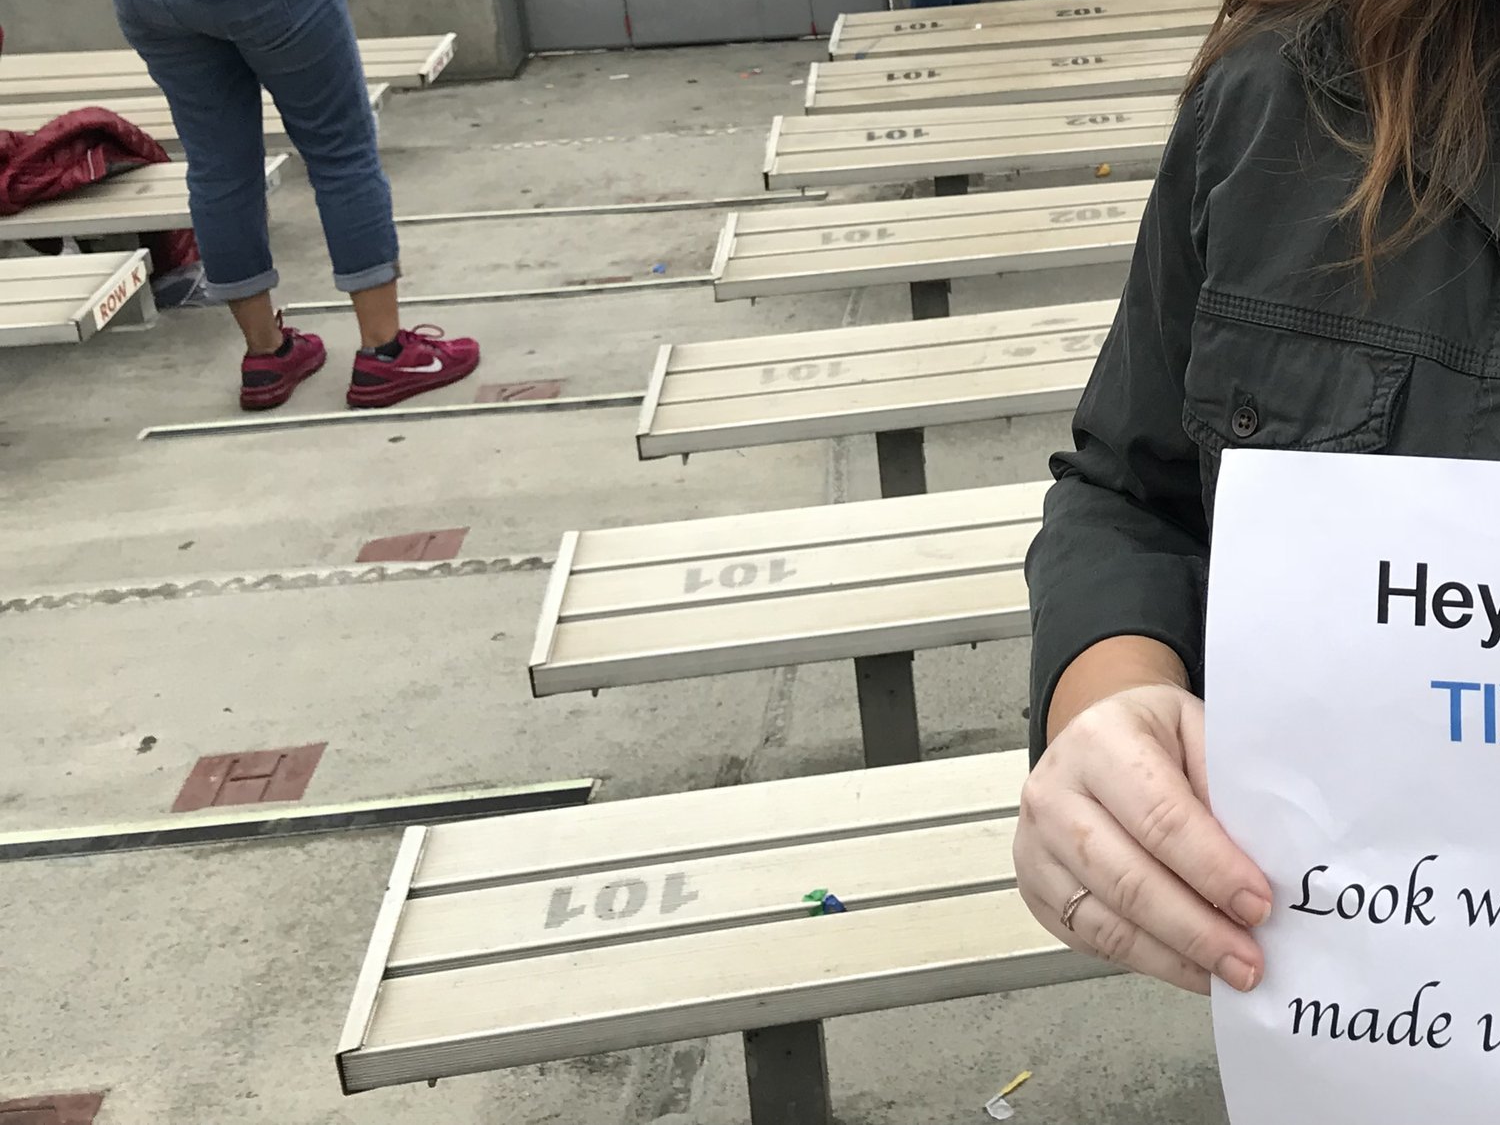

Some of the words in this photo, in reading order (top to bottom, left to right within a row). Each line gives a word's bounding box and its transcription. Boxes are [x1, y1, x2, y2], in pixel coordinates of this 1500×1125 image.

[894, 21, 943, 33] 101
[886, 69, 941, 83] 101
[865, 127, 930, 142] 101
[1048, 206, 1128, 224] 102
[820, 227, 896, 246] 101
[100, 280, 127, 322] ROW
[131, 266, 142, 287] K
[682, 557, 799, 595] 101
[543, 871, 700, 930] 101
[1288, 854, 1439, 928] Look
[1287, 981, 1453, 1050] made
